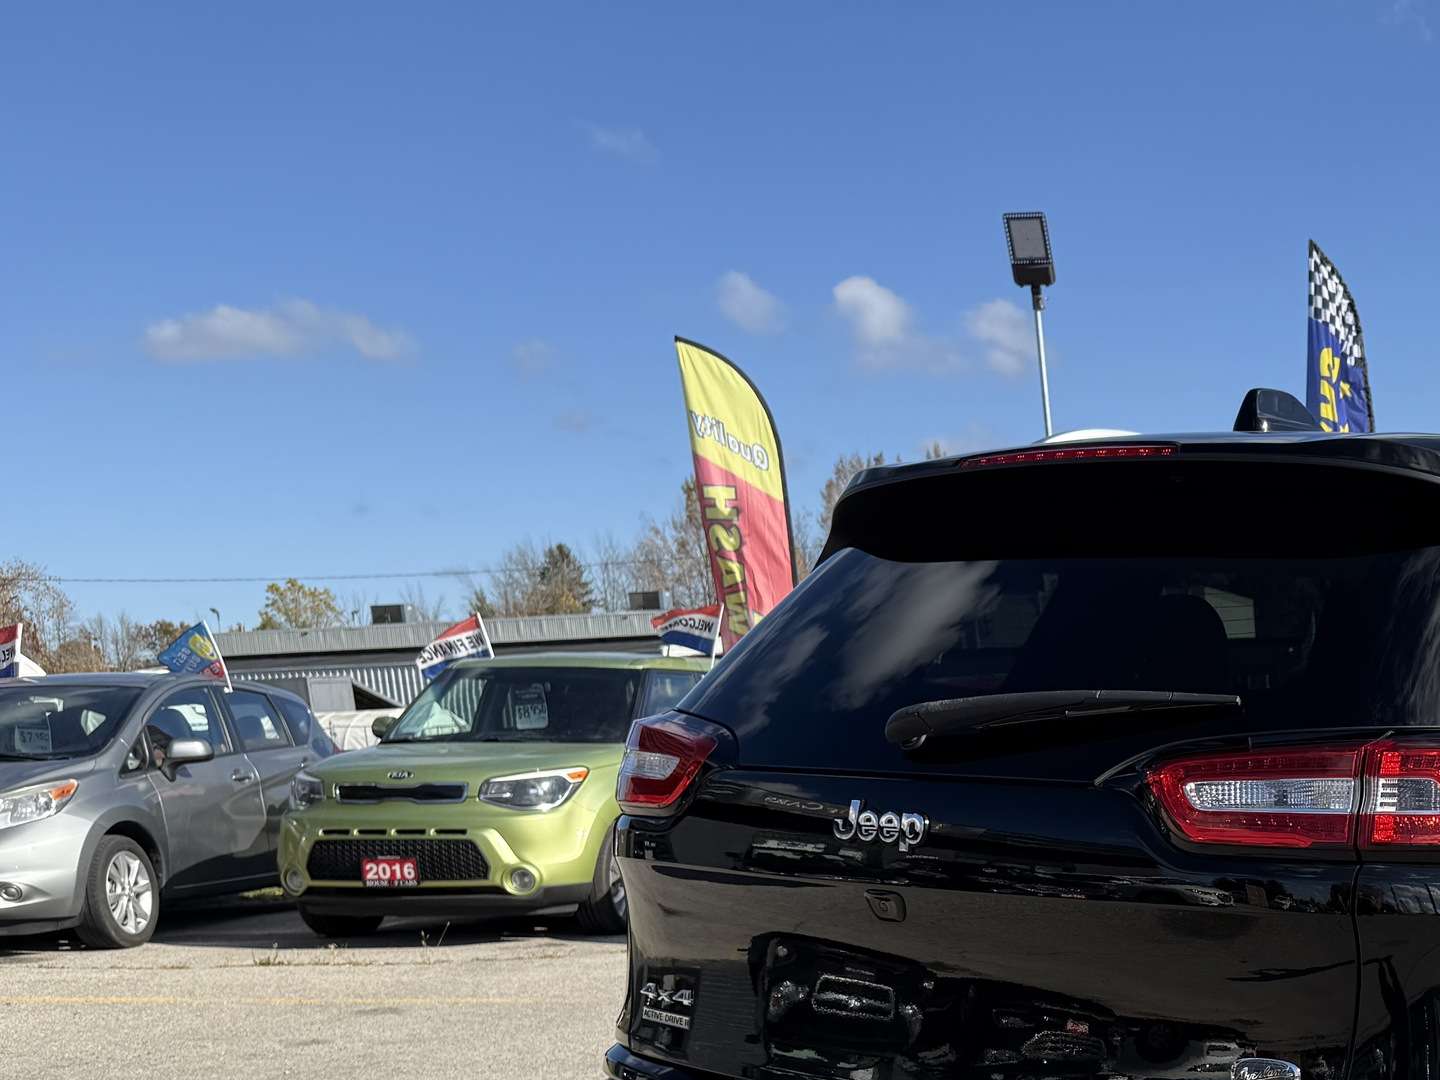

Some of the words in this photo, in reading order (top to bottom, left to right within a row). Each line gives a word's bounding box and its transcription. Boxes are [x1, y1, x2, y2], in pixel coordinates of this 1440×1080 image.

[833, 799, 926, 853] Jeep
[365, 862, 416, 881] 2016
[643, 1008, 665, 1021] ACTIVE
[664, 1014, 684, 1026] DRIVE
